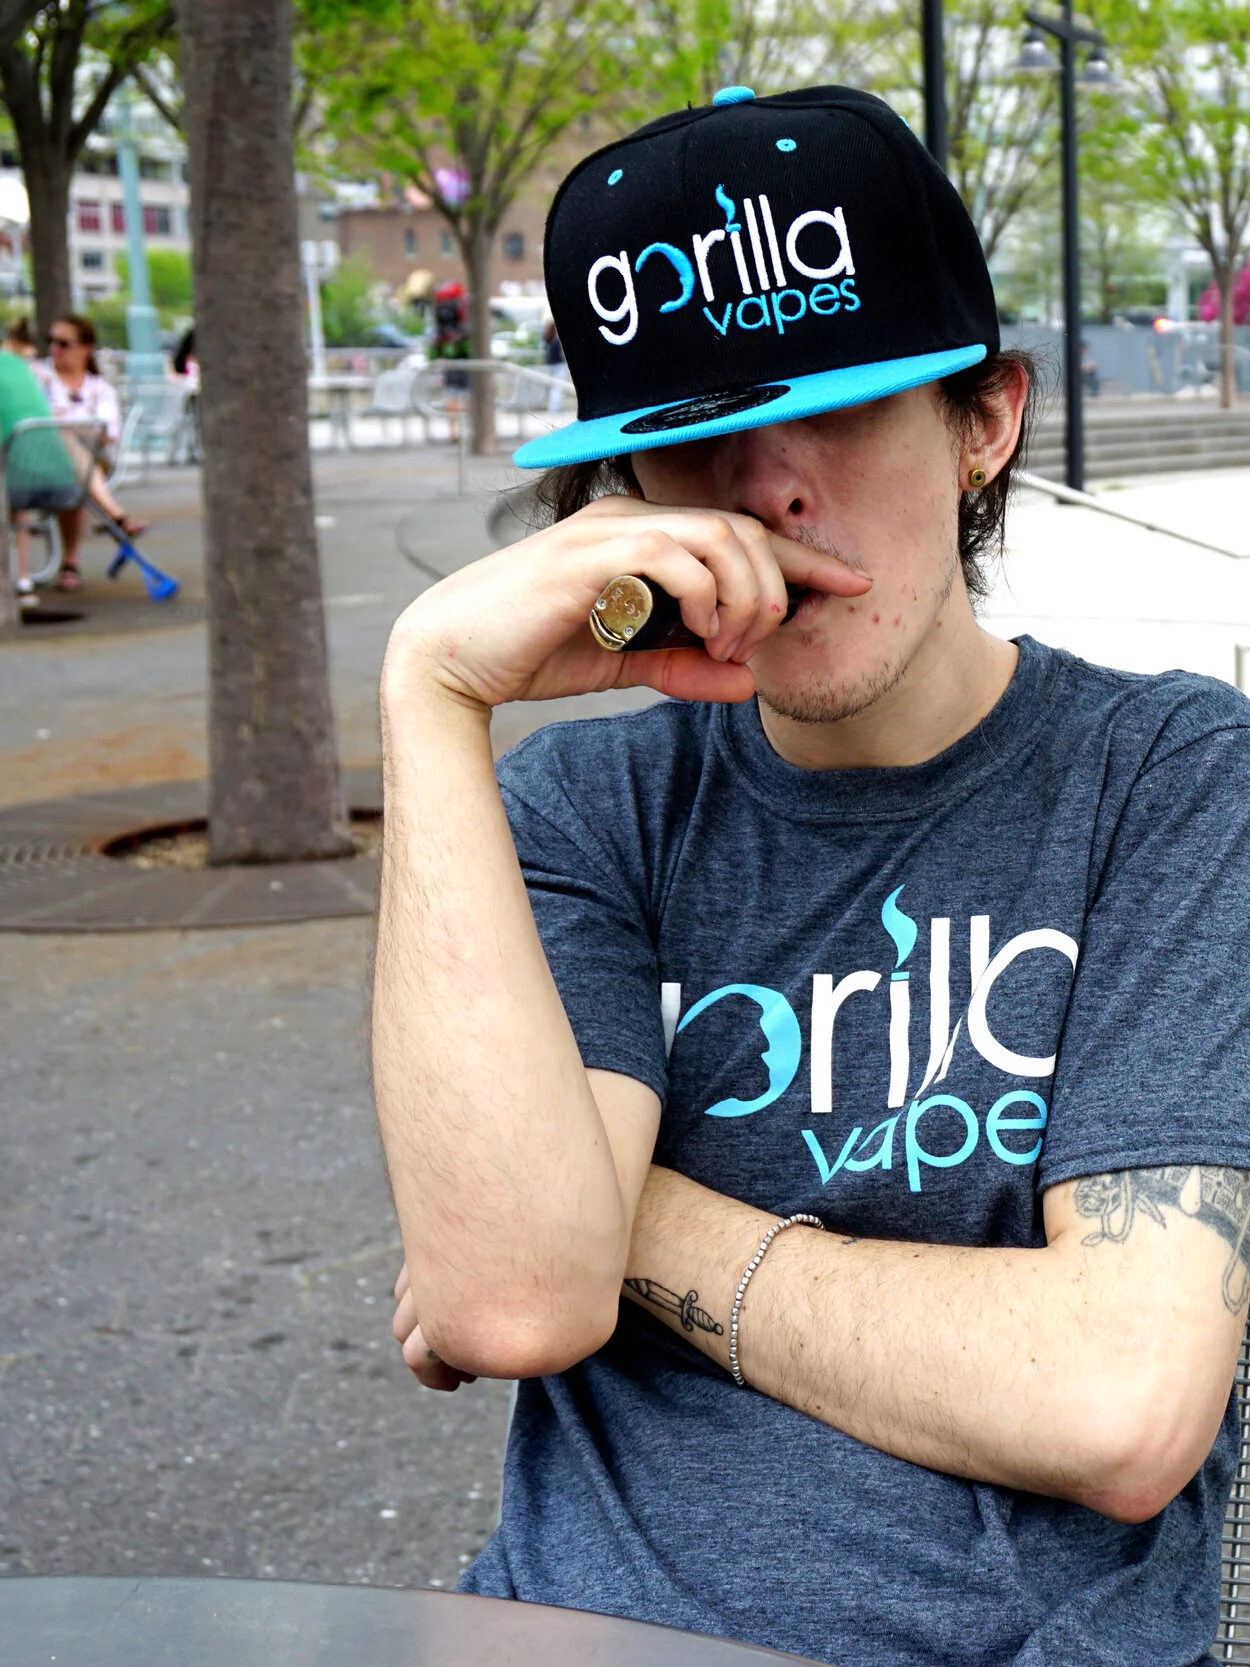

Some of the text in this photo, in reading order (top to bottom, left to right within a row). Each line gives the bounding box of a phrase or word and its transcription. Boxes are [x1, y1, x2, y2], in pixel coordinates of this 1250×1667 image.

[587, 184, 856, 346] gorilla
[702, 278, 861, 336] vapes
[661, 884, 1079, 1113] orilla
